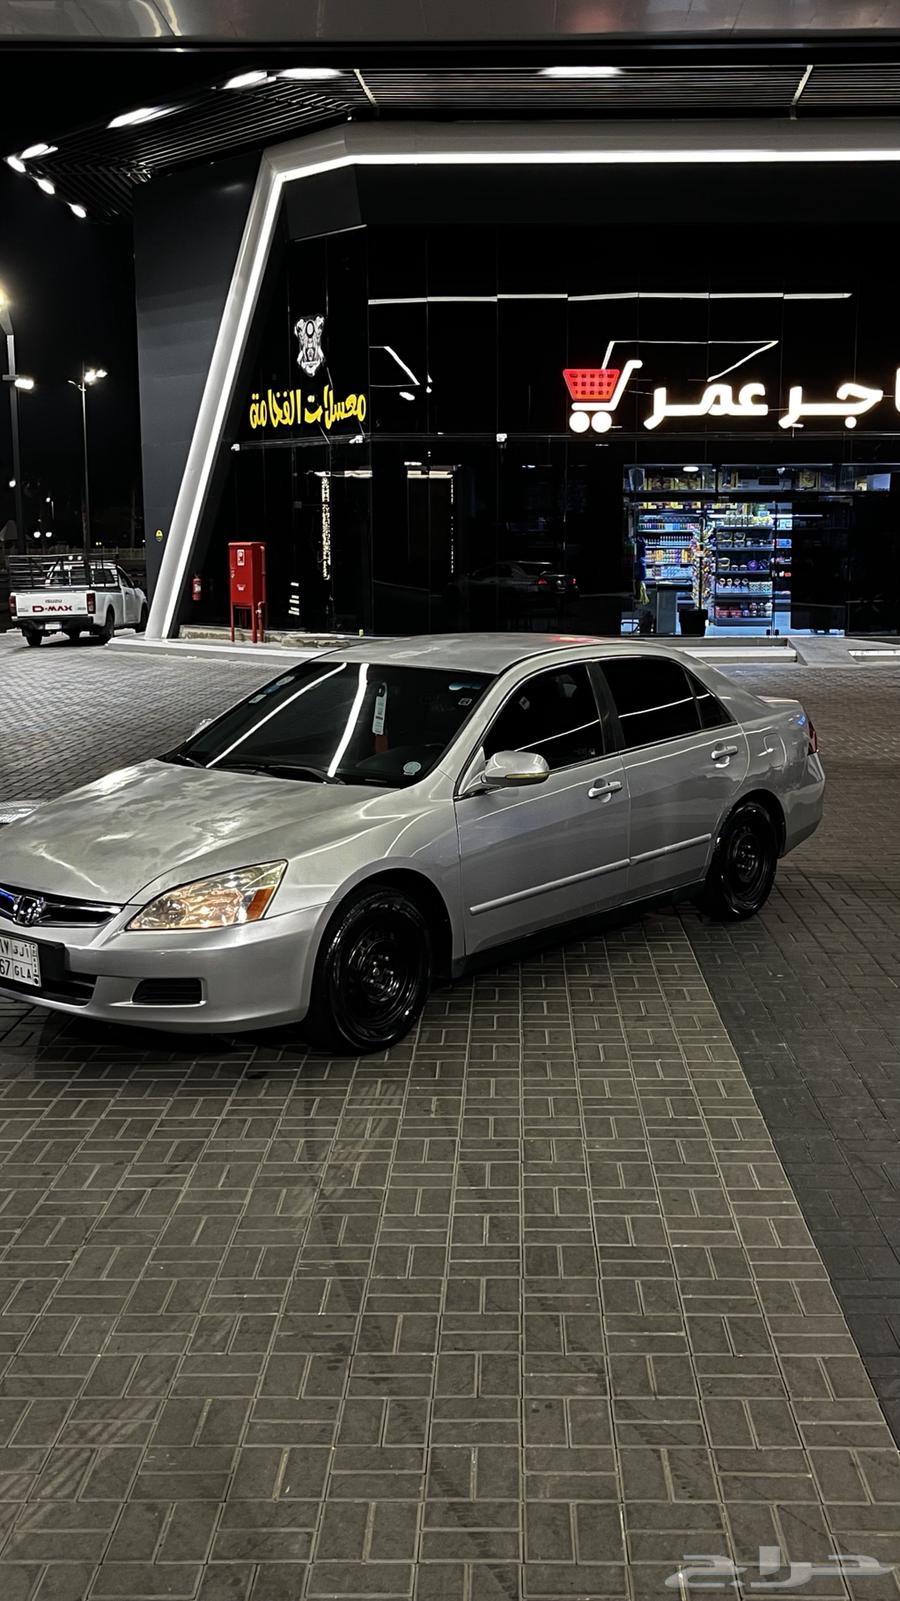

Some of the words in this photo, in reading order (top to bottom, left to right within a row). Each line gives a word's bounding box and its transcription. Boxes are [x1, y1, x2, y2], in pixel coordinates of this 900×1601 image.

[250, 389, 301, 429] الفخامة
[304, 385, 366, 429] معسلات
[643, 382, 768, 430] عمر
[32, 605, 73, 613] D-MAX
[14, 965, 32, 979] GLA
